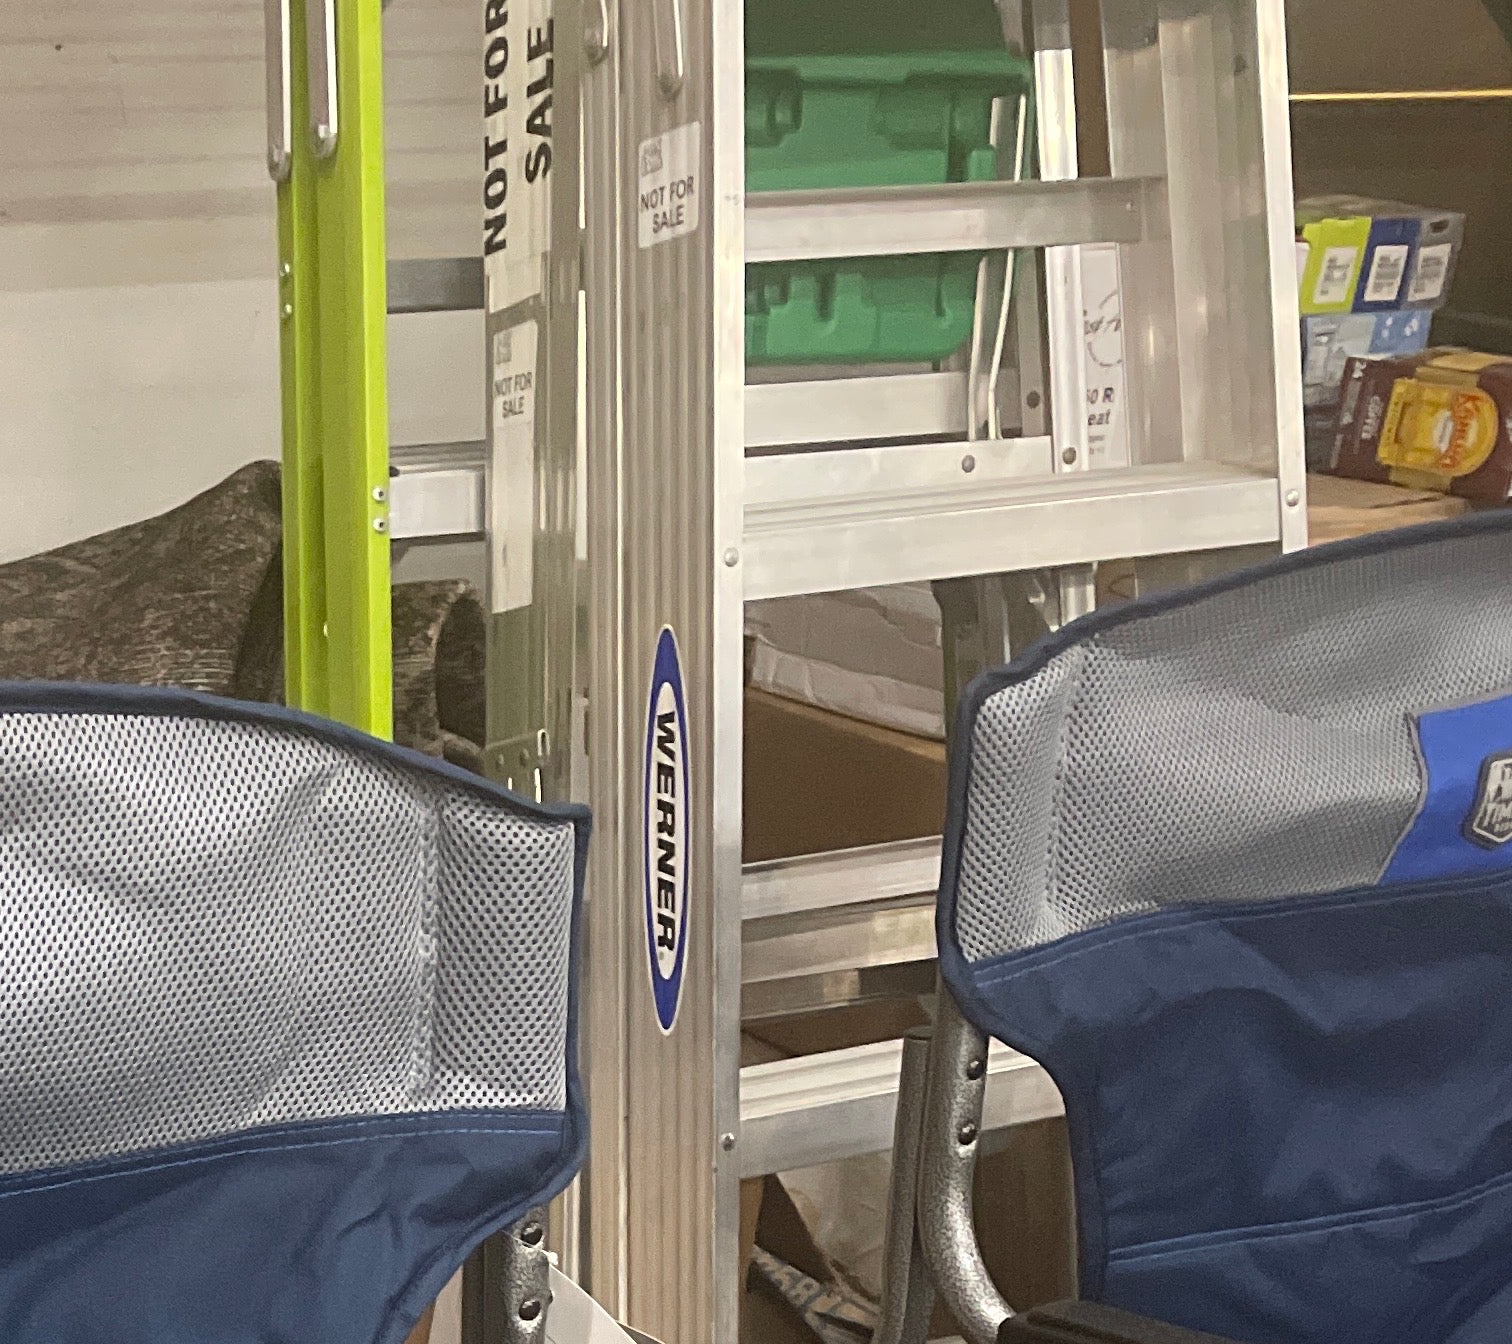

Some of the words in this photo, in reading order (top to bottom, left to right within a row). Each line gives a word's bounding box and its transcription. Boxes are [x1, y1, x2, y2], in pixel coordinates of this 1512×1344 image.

[484, 0, 509, 119] FOR
[525, 18, 554, 184] SALE
[484, 135, 508, 257] NOT
[640, 186, 665, 213] NOT
[670, 175, 694, 202] FOR
[652, 204, 685, 234] SALE
[494, 377, 513, 397] NOT
[514, 371, 533, 391] FOR
[502, 396, 525, 419] SALE
[656, 711, 676, 951] WERNER
